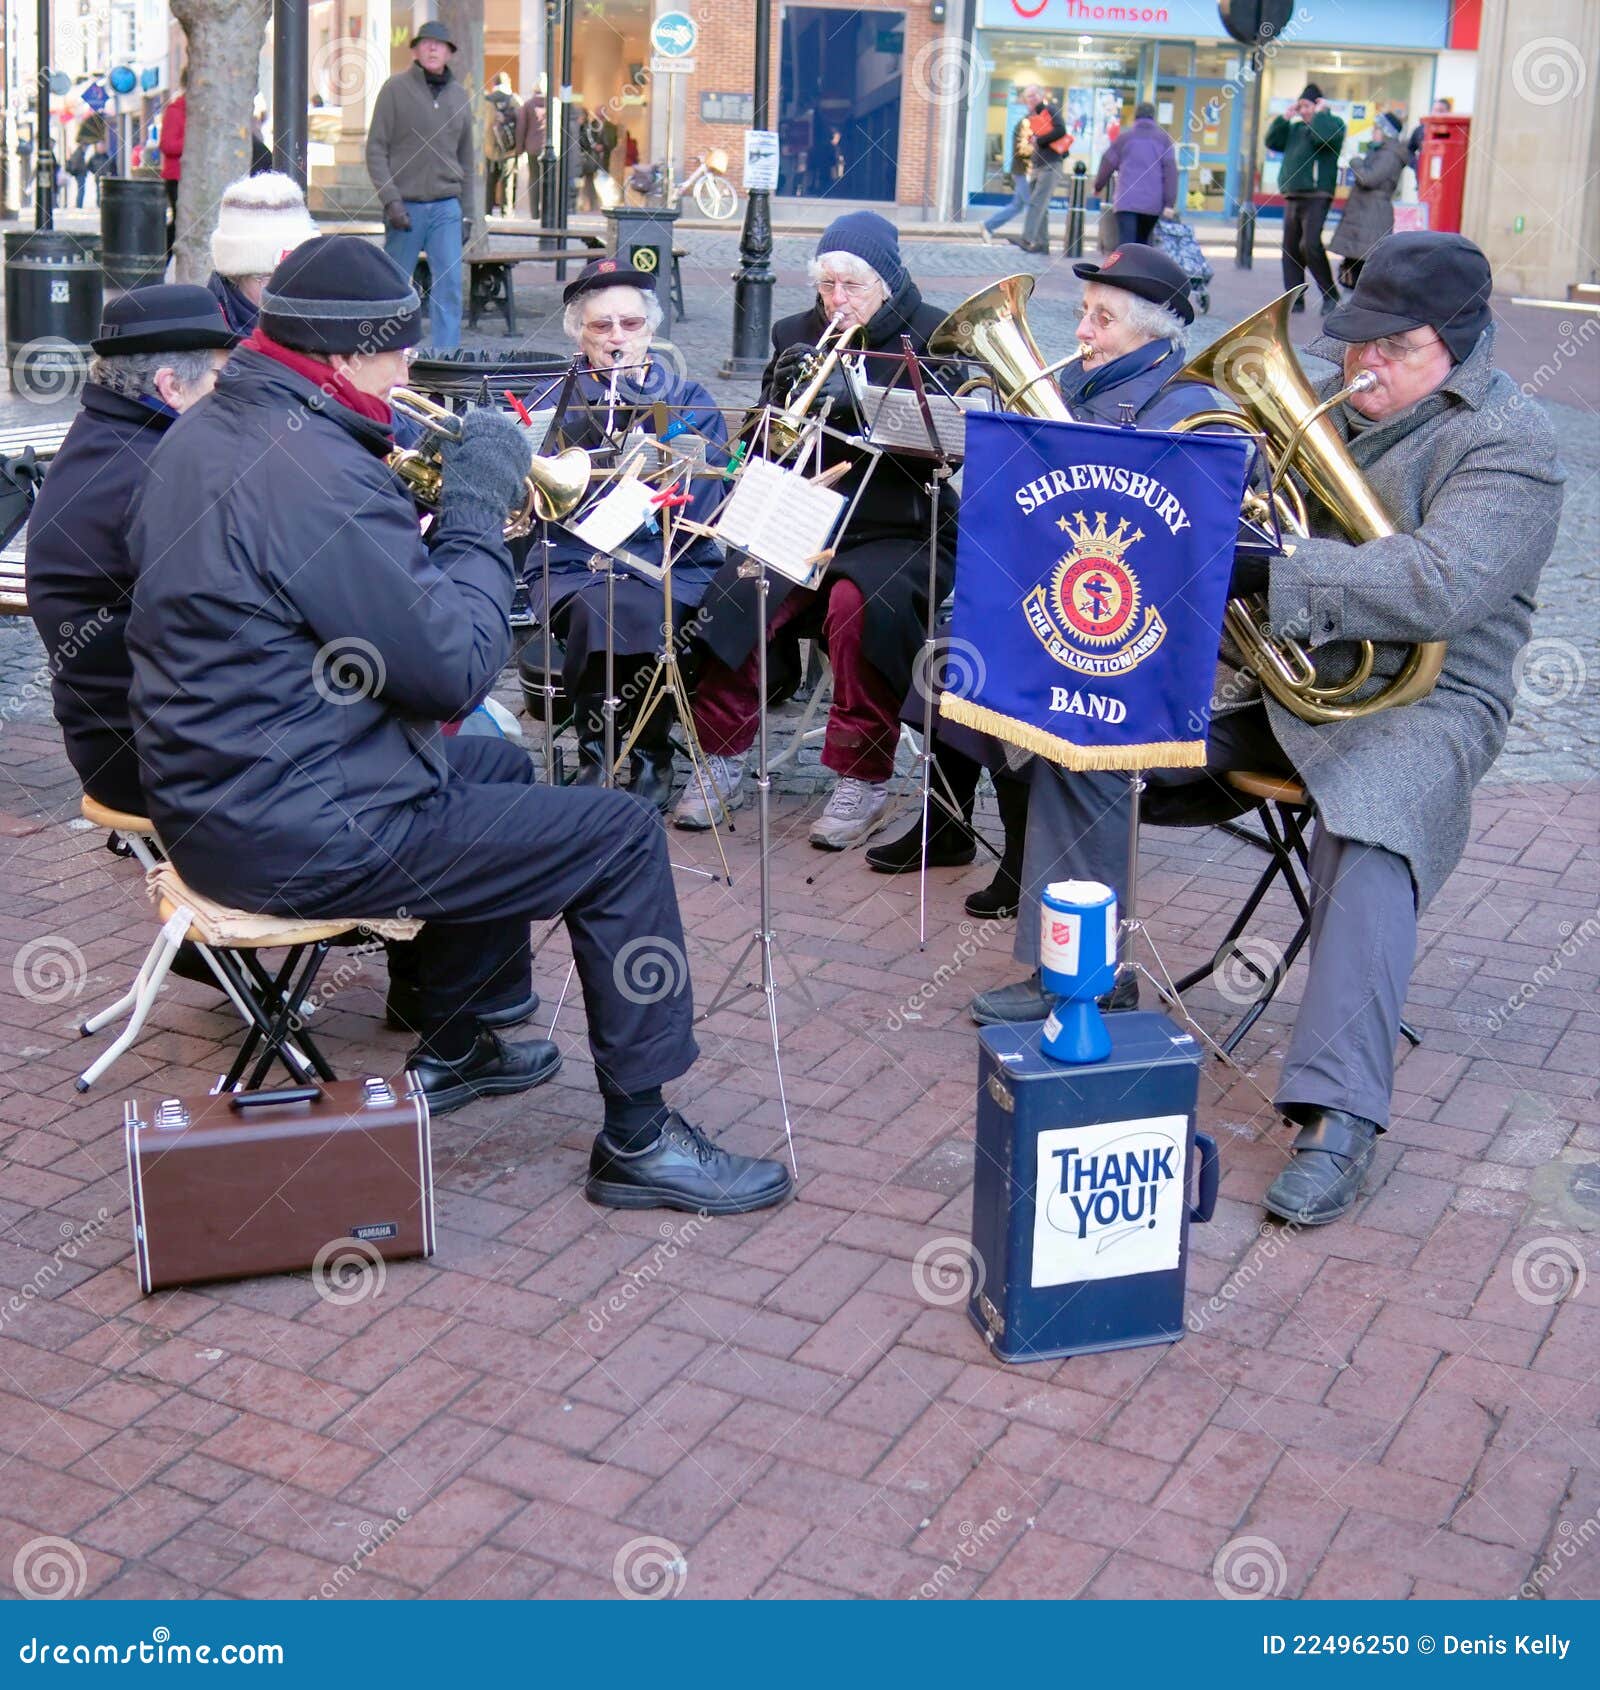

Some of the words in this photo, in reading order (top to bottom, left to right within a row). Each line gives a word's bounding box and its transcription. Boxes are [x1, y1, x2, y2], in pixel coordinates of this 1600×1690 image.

[1066, 0, 1169, 23] Thomson
[1015, 464, 1191, 536] SHREWSBURY
[1028, 602, 1052, 636] THE
[1049, 640, 1132, 673] SALVATION
[1133, 620, 1164, 658] ARMY
[1049, 686, 1127, 724] BAND
[1051, 1146, 1174, 1194] THANK
[357, 1226, 392, 1238] YAMAHA
[1069, 1184, 1157, 1239] YOU!
